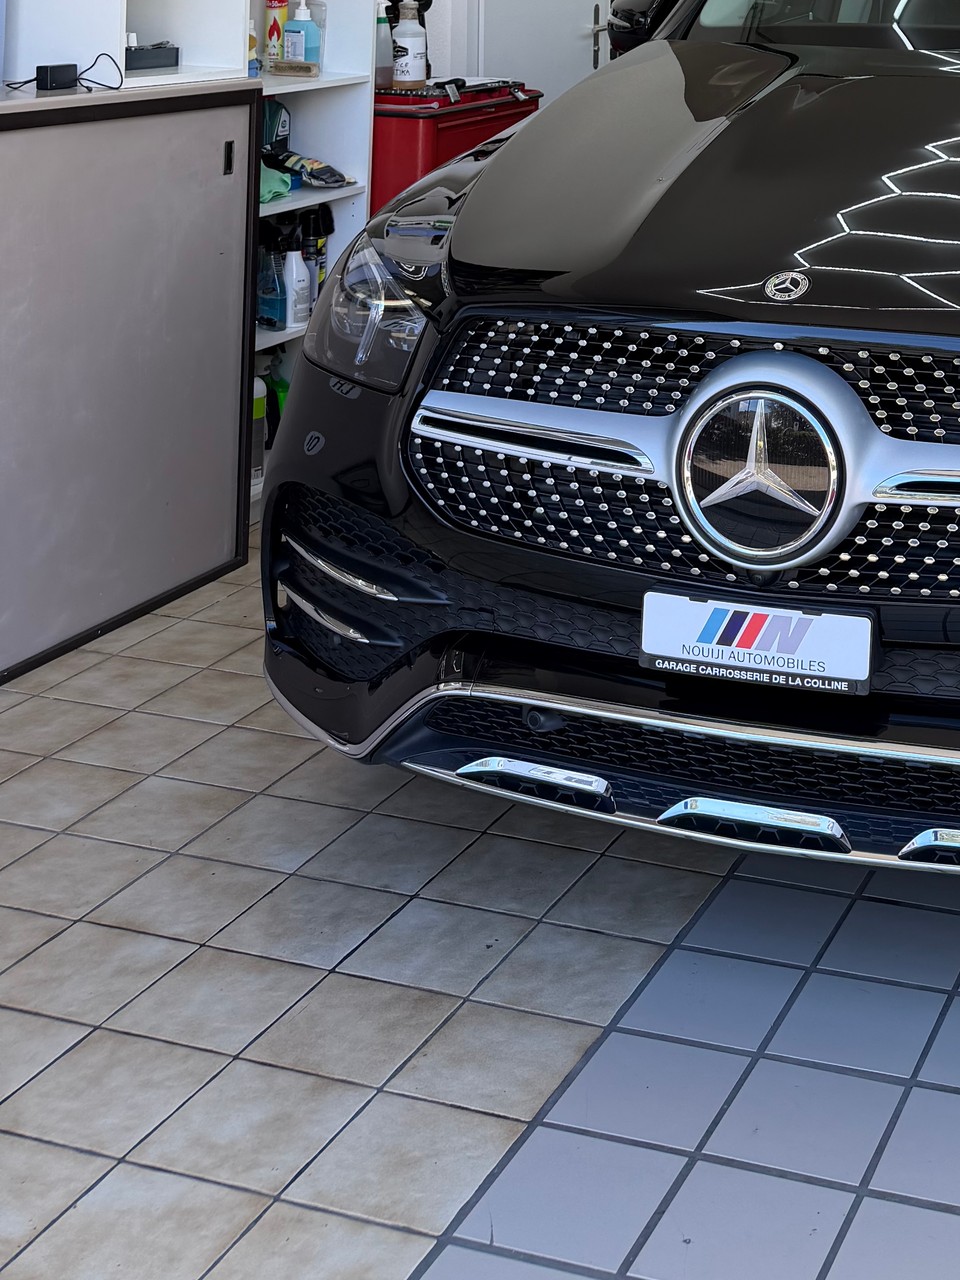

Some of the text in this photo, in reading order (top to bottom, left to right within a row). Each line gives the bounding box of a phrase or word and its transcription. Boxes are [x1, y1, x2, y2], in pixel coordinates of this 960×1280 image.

[681, 644, 827, 673] NOUIJI AUTOMOBILES
[655, 659, 849, 691] GARAGE CARROSSERIE DE LA COLLINE
